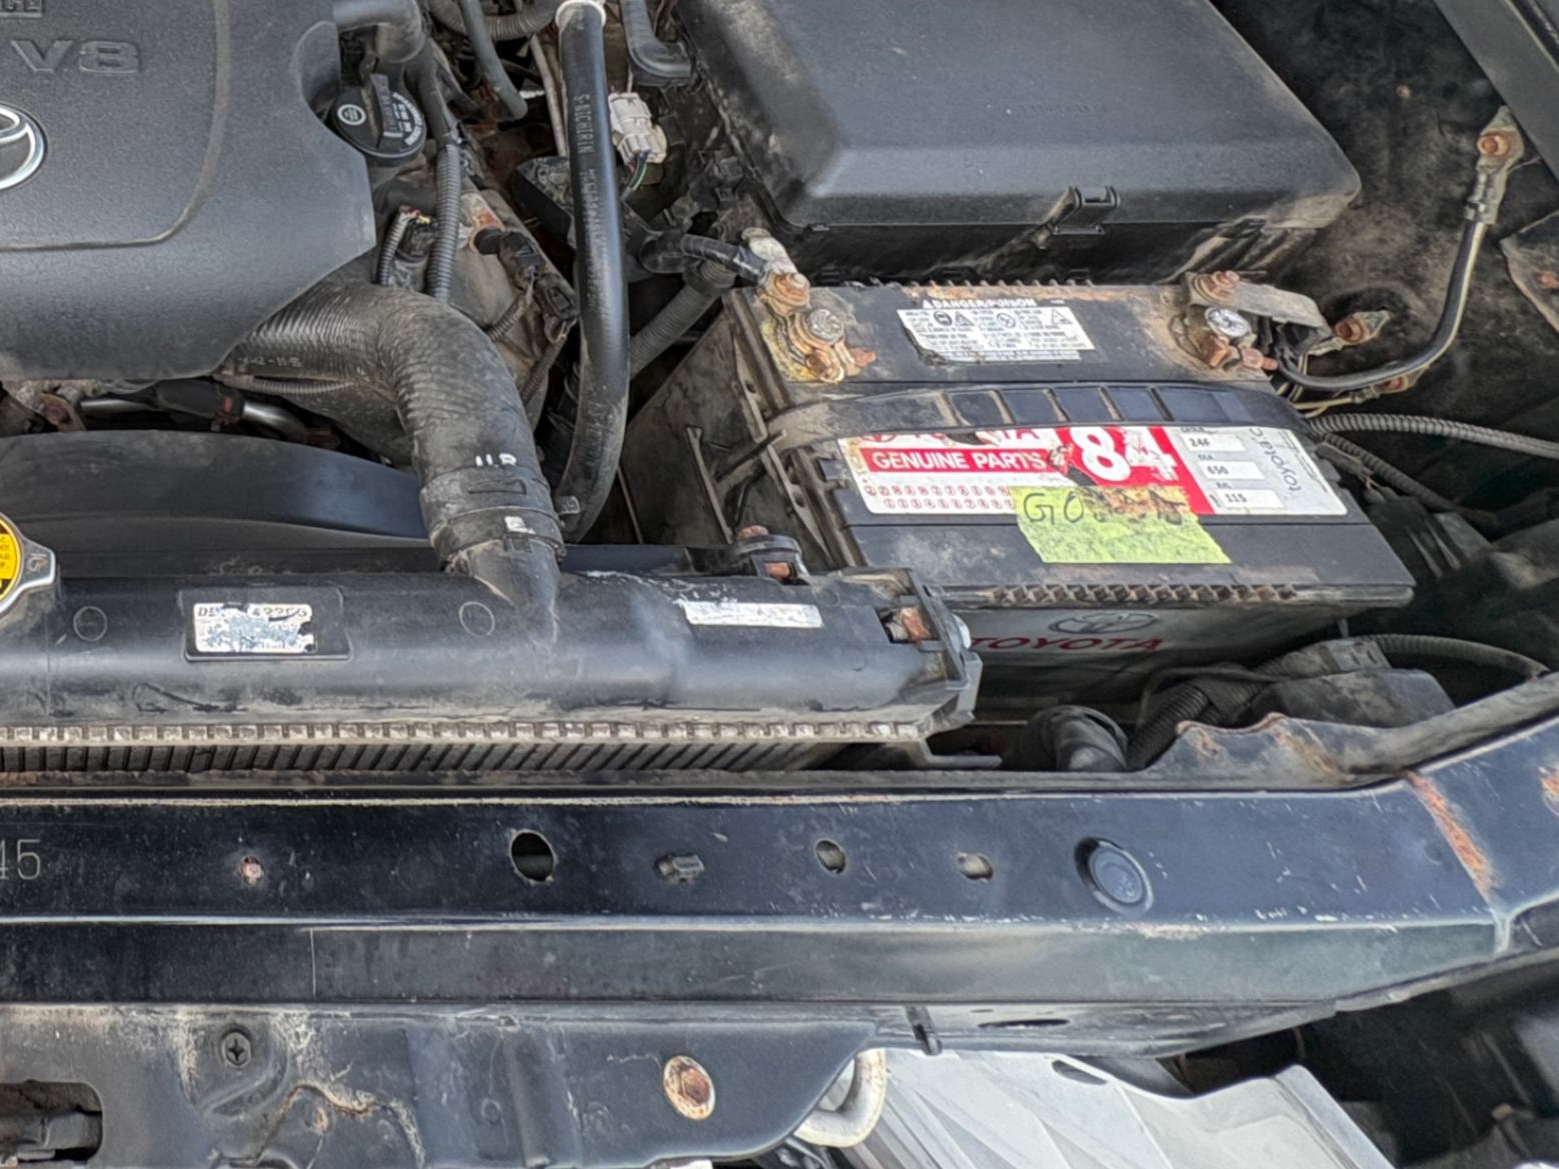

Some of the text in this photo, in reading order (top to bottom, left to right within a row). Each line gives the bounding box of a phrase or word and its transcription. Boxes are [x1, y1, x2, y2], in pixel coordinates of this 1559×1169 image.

[11, 39, 140, 74] V8
[872, 451, 1046, 469] GENUINE PARTS
[972, 637, 1163, 651] TOYOTA
